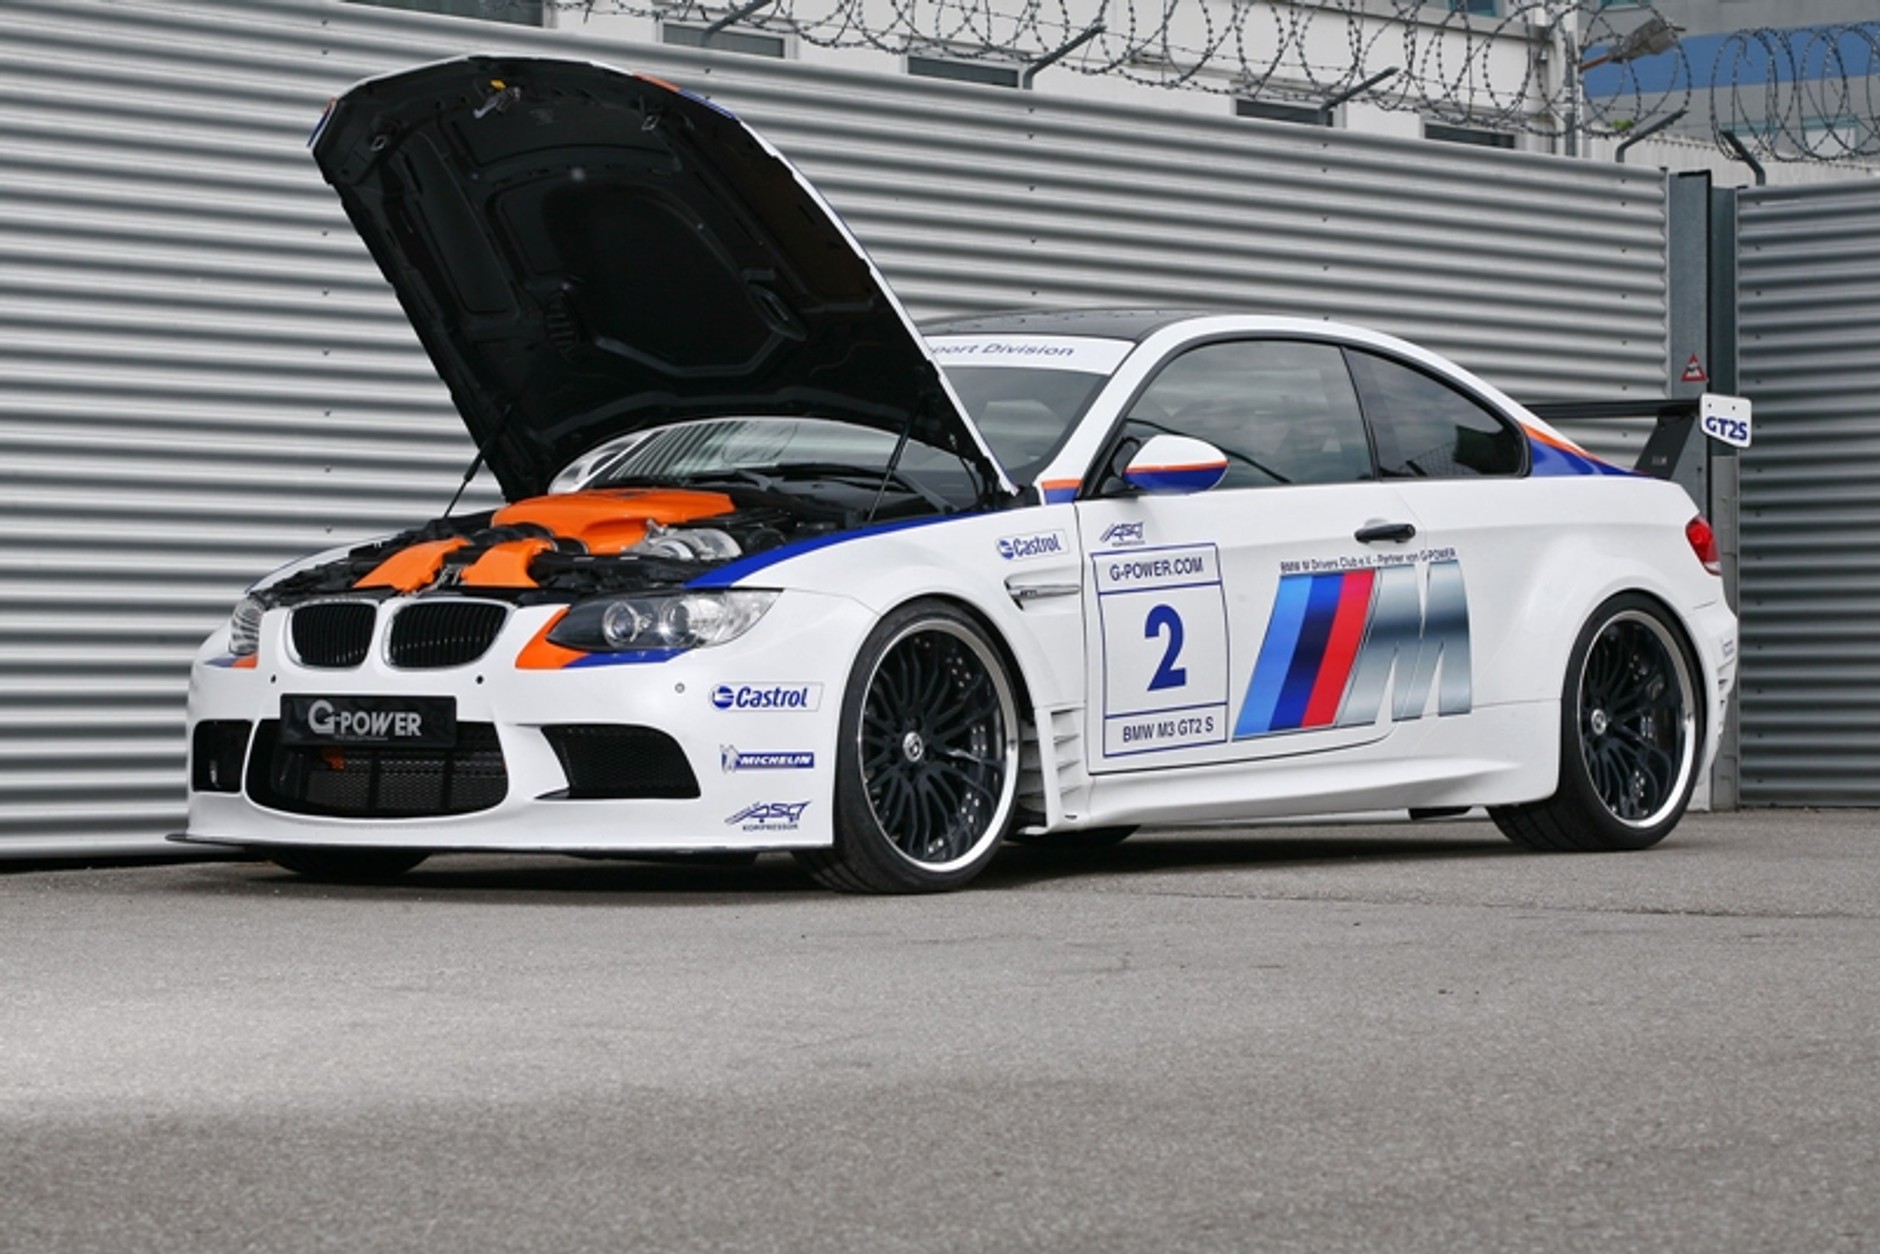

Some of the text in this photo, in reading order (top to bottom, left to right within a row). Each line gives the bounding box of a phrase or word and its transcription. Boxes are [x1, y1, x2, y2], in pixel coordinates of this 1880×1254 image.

[982, 343, 1074, 356] Division
[1705, 416, 1748, 441] GT2S
[1013, 533, 1061, 557] Castrol
[1109, 557, 1204, 581] G-POWER.COM
[1280, 560, 1300, 572] BMW
[1302, 560, 1310, 570] M
[1311, 558, 1338, 570] Drivers
[1339, 556, 1357, 568] Club
[1377, 553, 1404, 565] Partner
[1144, 603, 1187, 692] 2
[736, 686, 807, 708] Castrol
[308, 699, 422, 737] G-POWER
[1123, 716, 1214, 743] BMW M3 GT2 S
[740, 755, 812, 765] MICHELIN
